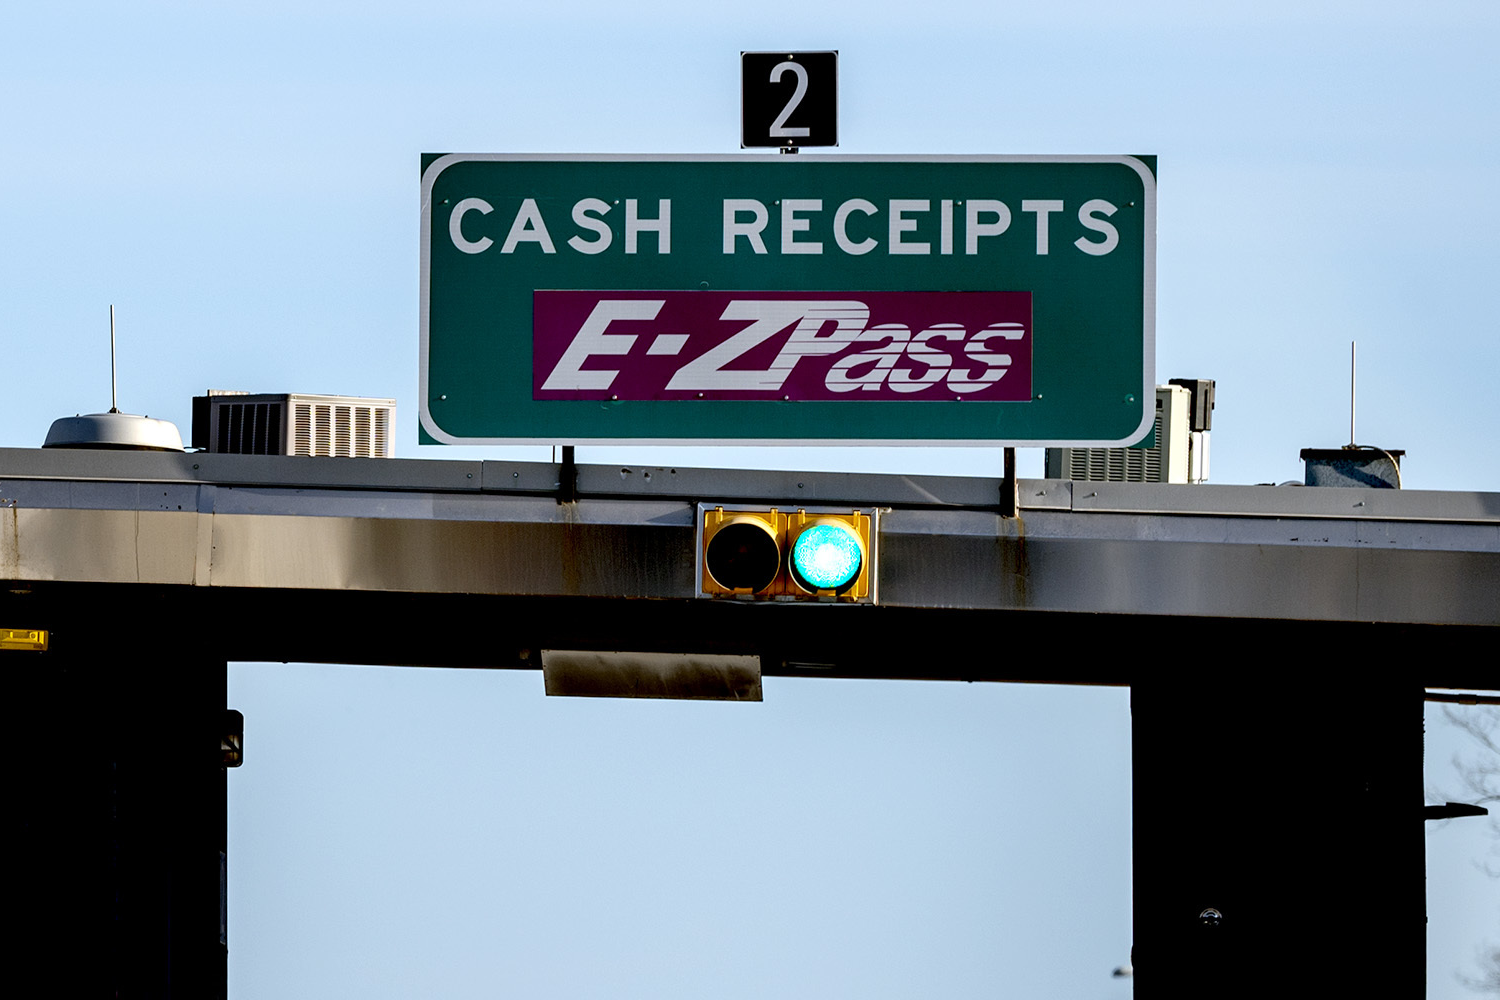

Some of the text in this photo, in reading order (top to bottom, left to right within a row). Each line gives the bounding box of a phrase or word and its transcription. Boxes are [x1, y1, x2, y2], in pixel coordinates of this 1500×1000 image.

[769, 62, 811, 138] 2
[448, 197, 1120, 256] CASH RECEIPTS
[540, 299, 1026, 393] E-ZPass
